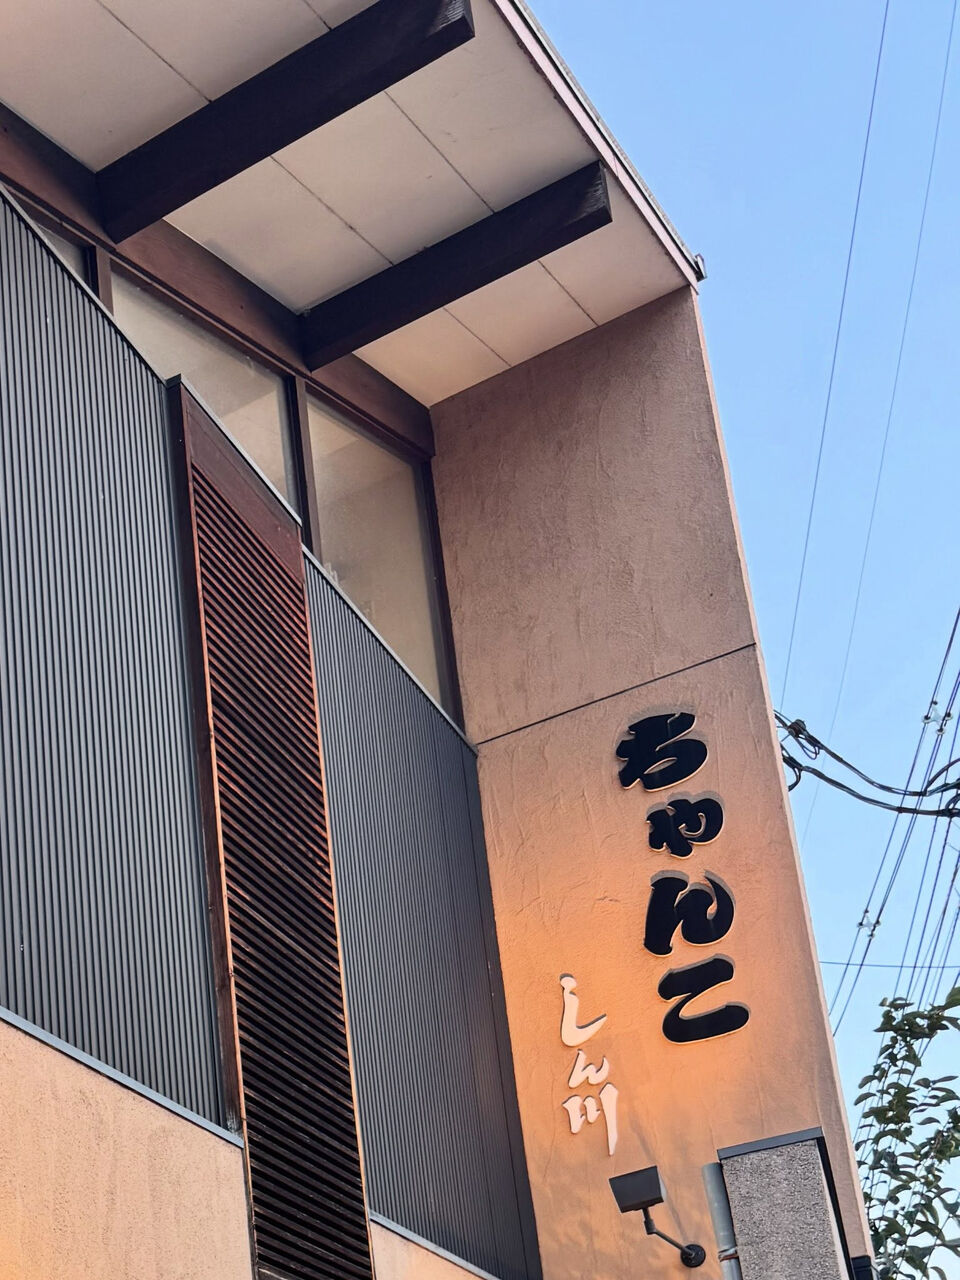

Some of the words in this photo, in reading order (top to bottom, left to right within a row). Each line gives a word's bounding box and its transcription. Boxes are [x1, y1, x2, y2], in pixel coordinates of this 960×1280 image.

[616, 712, 750, 1044] ちゃんこ
[560, 974, 619, 1157] しん川
